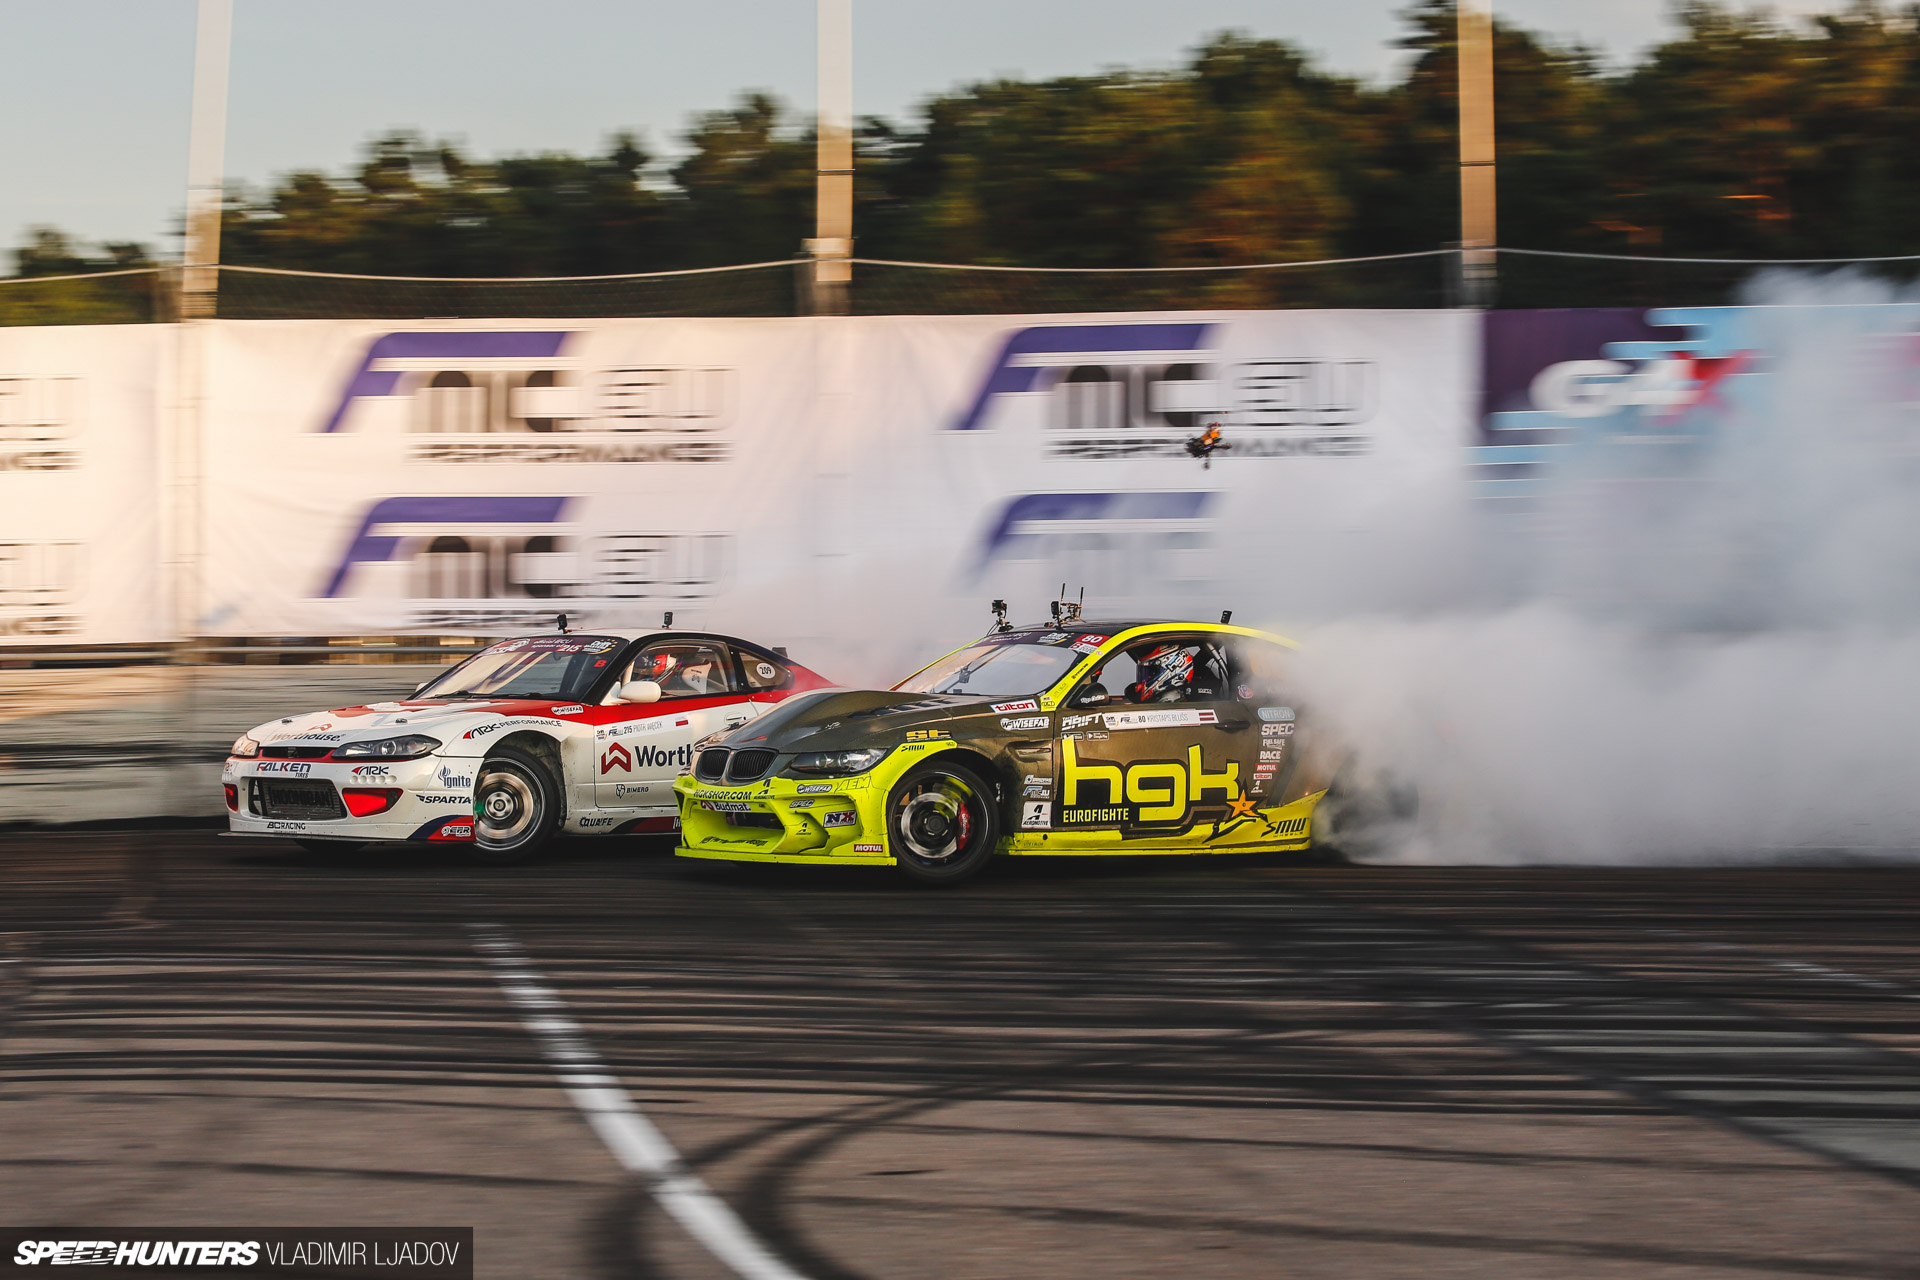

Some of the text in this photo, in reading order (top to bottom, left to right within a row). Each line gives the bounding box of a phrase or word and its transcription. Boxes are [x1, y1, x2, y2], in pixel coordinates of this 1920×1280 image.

[1081, 635, 1104, 644] 80
[557, 645, 581, 653] 215
[593, 659, 608, 668] B
[759, 666, 772, 675] 209
[994, 701, 1035, 712] tilton
[1138, 715, 1146, 723] 80
[1261, 709, 1291, 719] NITRON
[500, 719, 563, 727] PERFORMANCE
[623, 725, 633, 735] 215
[1260, 723, 1295, 736] SPEC
[1259, 750, 1282, 760] RACE
[256, 762, 312, 774] FALKEN
[443, 773, 472, 789] ignite
[1062, 735, 1240, 822] hgk
[424, 794, 472, 804] SPARTA
[790, 799, 815, 808] SPEC
[826, 811, 856, 824] NX
[281, 822, 307, 831] RACING
